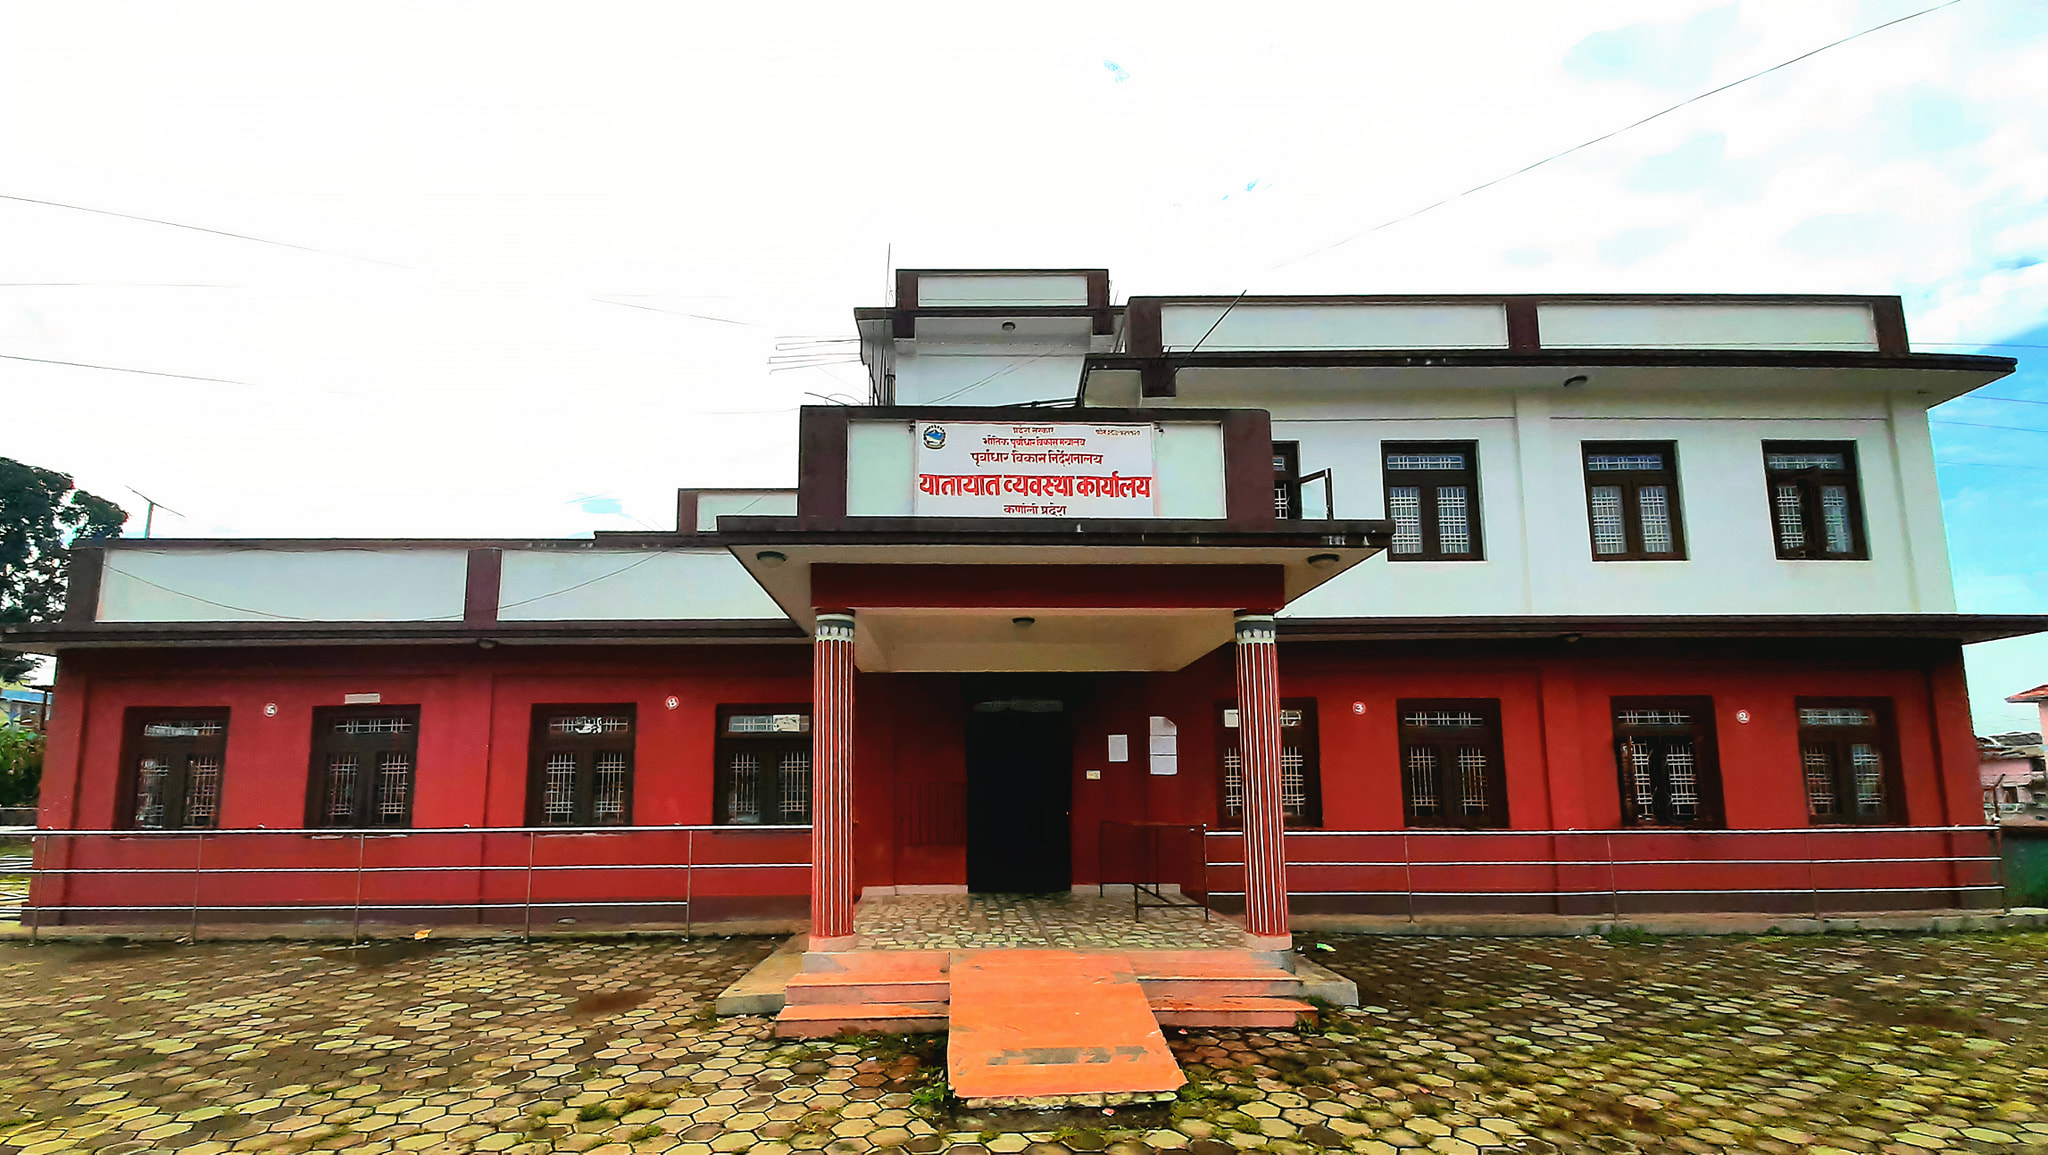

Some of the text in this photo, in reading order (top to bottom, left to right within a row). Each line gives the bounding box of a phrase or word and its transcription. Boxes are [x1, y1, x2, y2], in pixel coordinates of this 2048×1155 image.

[982, 434, 1009, 446] भौतिक
[970, 449, 1104, 467] पूर्वाधार विकास निर्देशनालय
[919, 470, 1152, 498] यातायात व्यवस्था कार्यालय
[1003, 501, 1068, 517] कर्णाली प्रदेश
